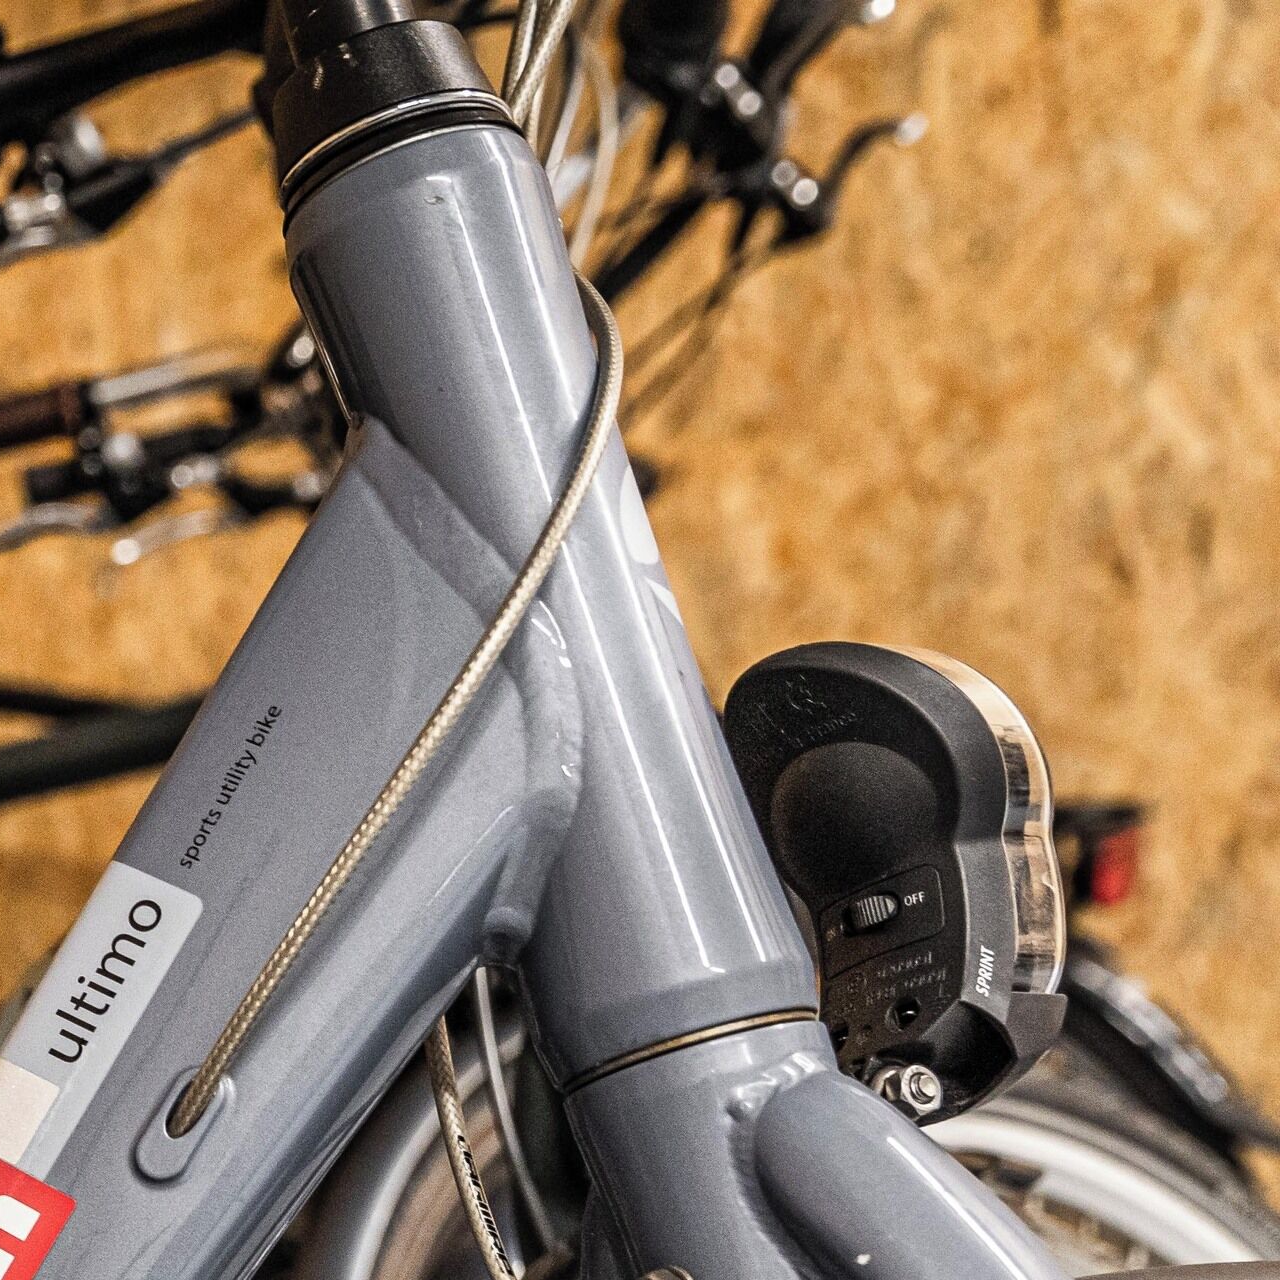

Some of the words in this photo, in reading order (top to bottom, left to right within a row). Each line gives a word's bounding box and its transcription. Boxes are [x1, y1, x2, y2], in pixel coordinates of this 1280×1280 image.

[179, 808, 222, 870] sports
[215, 749, 258, 806] utility
[245, 704, 283, 748] bike
[903, 890, 927, 908] OFF
[47, 899, 163, 1064] ultimo
[974, 944, 996, 999] SPRINT
